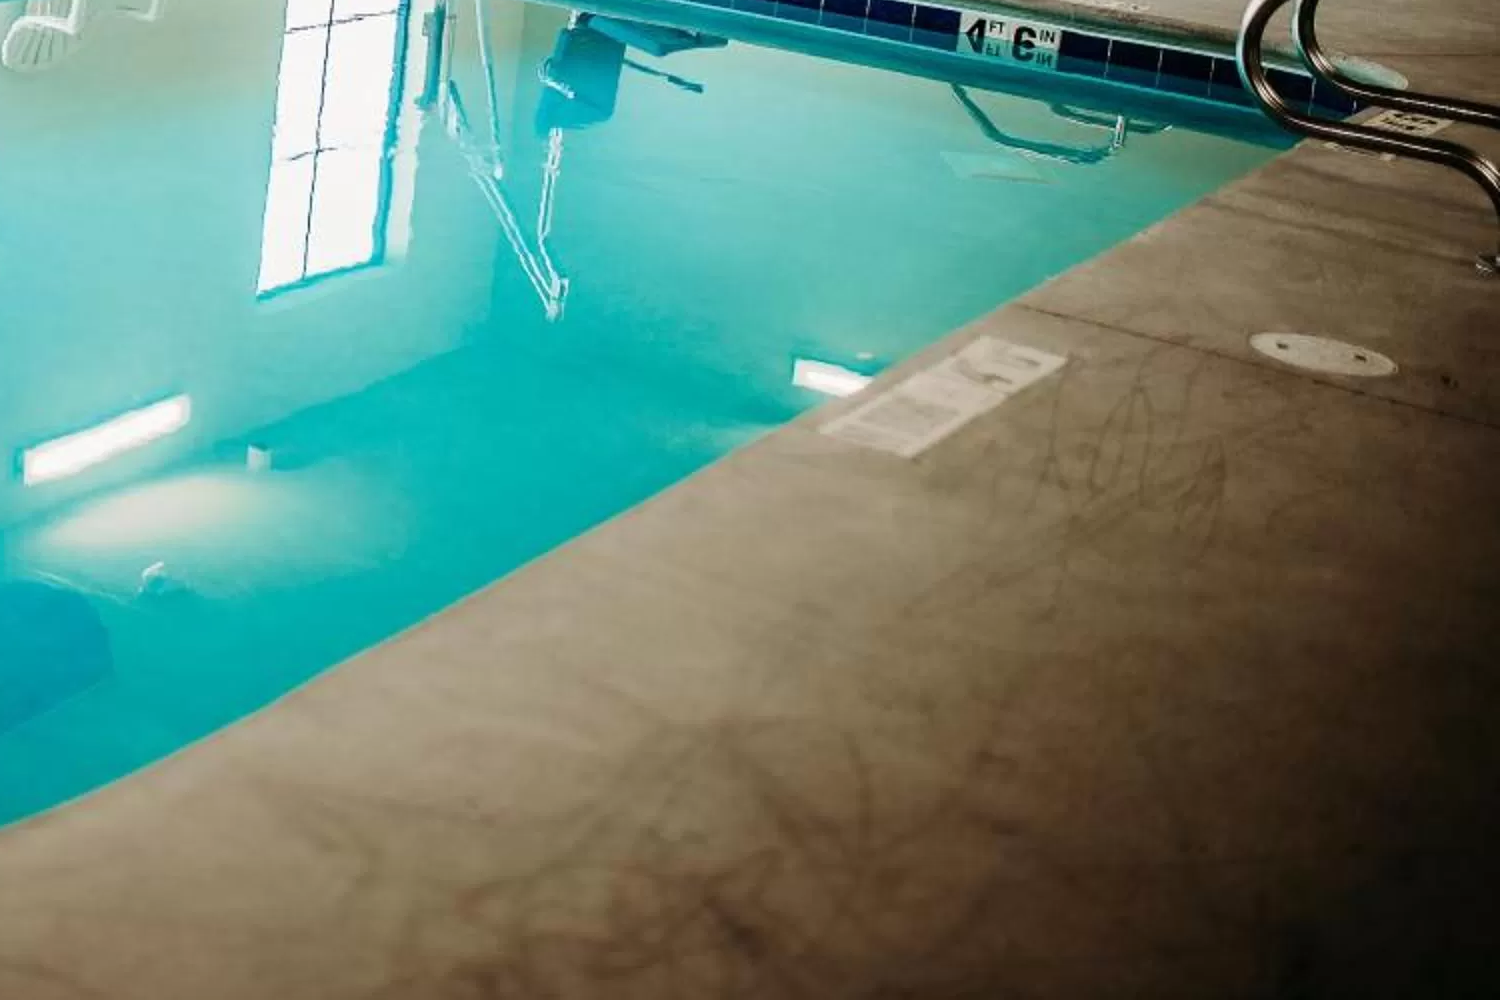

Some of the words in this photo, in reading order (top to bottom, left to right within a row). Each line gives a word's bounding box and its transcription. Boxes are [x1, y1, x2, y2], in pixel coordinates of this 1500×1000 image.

[966, 18, 987, 41] 4
[989, 20, 1005, 34] FT
[1013, 26, 1037, 50] 6
[1040, 30, 1055, 43] IN
